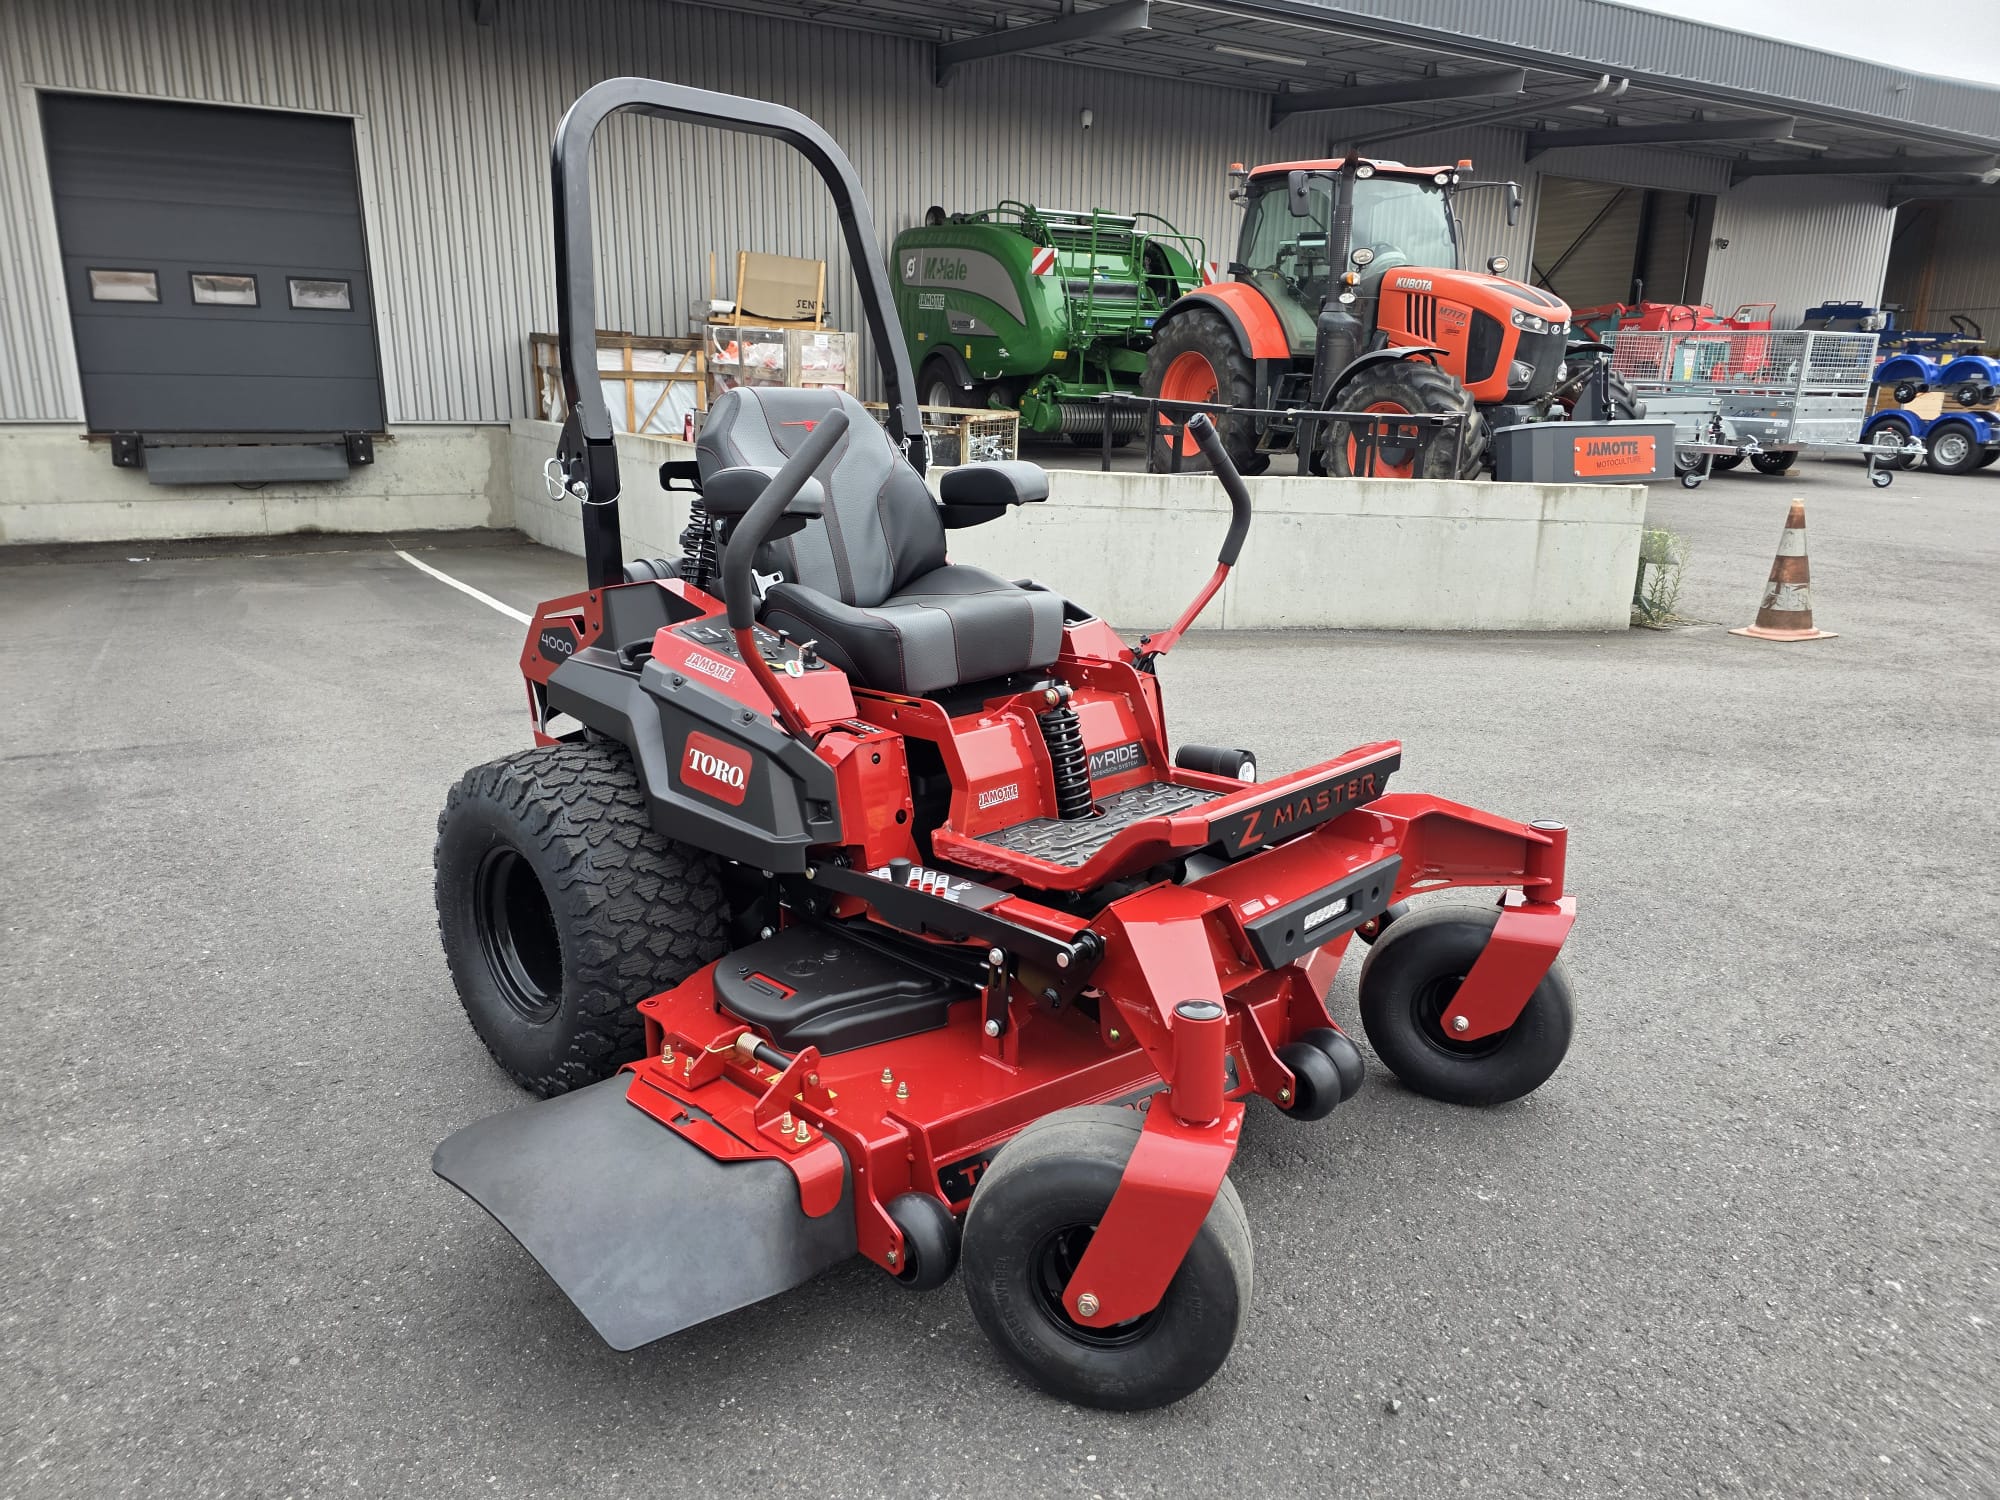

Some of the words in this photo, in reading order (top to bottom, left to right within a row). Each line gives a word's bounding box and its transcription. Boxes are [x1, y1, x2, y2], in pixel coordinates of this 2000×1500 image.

[1395, 277, 1433, 291] KUBOTA
[1586, 441, 1638, 456] JAMOTTE
[541, 633, 573, 655] 4000
[686, 653, 736, 680] JAMOTTE
[689, 748, 744, 787] TORO
[979, 784, 1018, 806] JAMOTTE
[1238, 808, 1265, 848] Z
[1273, 772, 1377, 829] MASTER
